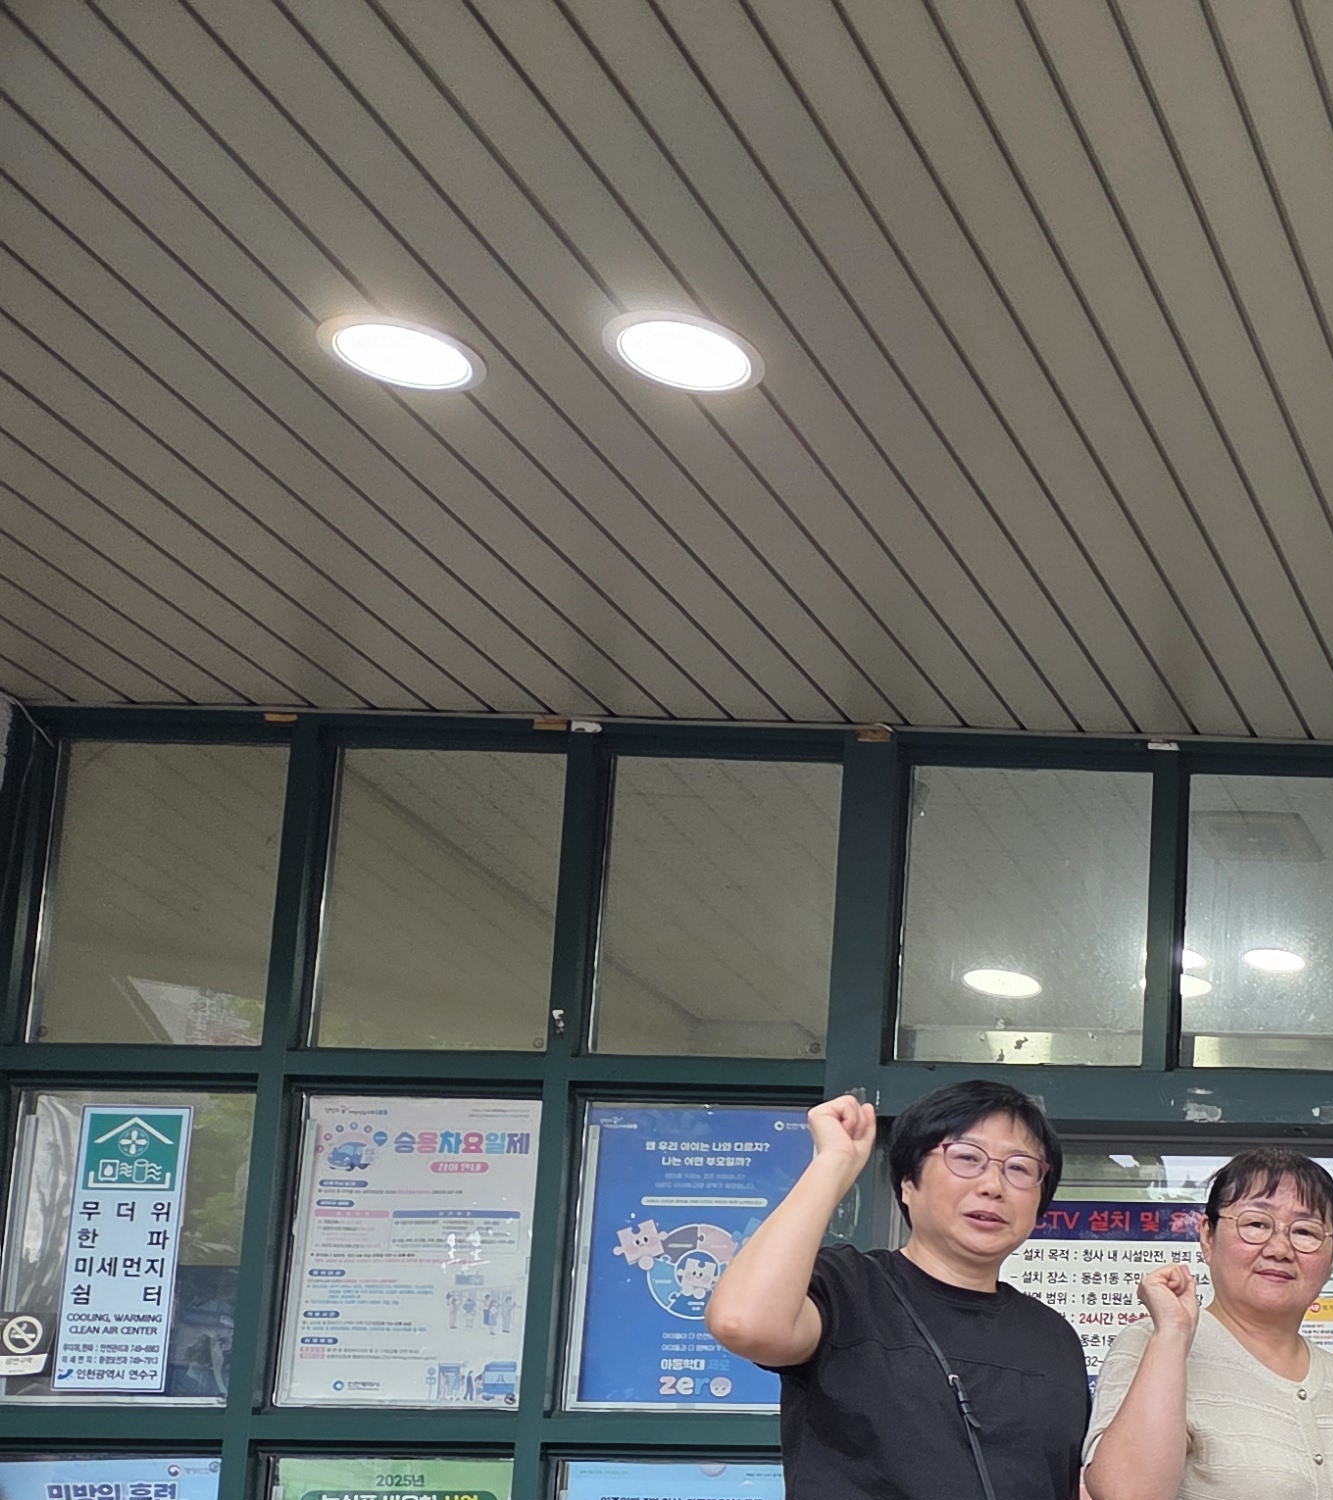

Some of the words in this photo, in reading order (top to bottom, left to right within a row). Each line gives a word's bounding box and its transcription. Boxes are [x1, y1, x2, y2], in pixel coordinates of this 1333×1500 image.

[394, 1131, 530, 1154] 승용차요일제
[646, 1142, 655, 1150] 왜
[658, 1142, 677, 1150] 우리
[712, 1142, 731, 1151] 나와
[662, 1157, 681, 1166] 나는
[684, 1157, 703, 1166] 어떤
[706, 1157, 751, 1167] 부모일까?
[1088, 1210, 1130, 1232] 설치
[1140, 1211, 1159, 1232] 및
[1022, 1249, 1043, 1261] 설치
[1048, 1249, 1069, 1261] 목적
[1082, 1249, 1104, 1262] 청사
[1108, 1249, 1117, 1262] 내
[1122, 1250, 1166, 1263] 시설안전,
[1171, 1251, 1191, 1263] 범죄
[74, 1256, 165, 1278] 미세먼지
[1022, 1271, 1042, 1284] 설치
[1047, 1272, 1068, 1284] 장소
[1081, 1273, 1119, 1285] 동춘1동
[1046, 1292, 1067, 1304] 범위
[1081, 1293, 1097, 1305] 1층
[1101, 1293, 1132, 1305] 민원실
[66, 1313, 111, 1323] COOLING,
[114, 1314, 162, 1323] WARMING
[1079, 1313, 1114, 1325] 24시간
[69, 1326, 100, 1334] CLEAN
[102, 1326, 118, 1335] AIR
[121, 1326, 157, 1335] CENTER
[661, 1359, 705, 1370] 아동학대
[76, 1369, 125, 1380] 인천광역시
[128, 1370, 158, 1379] 연수구
[376, 1475, 425, 1487] 2025년
